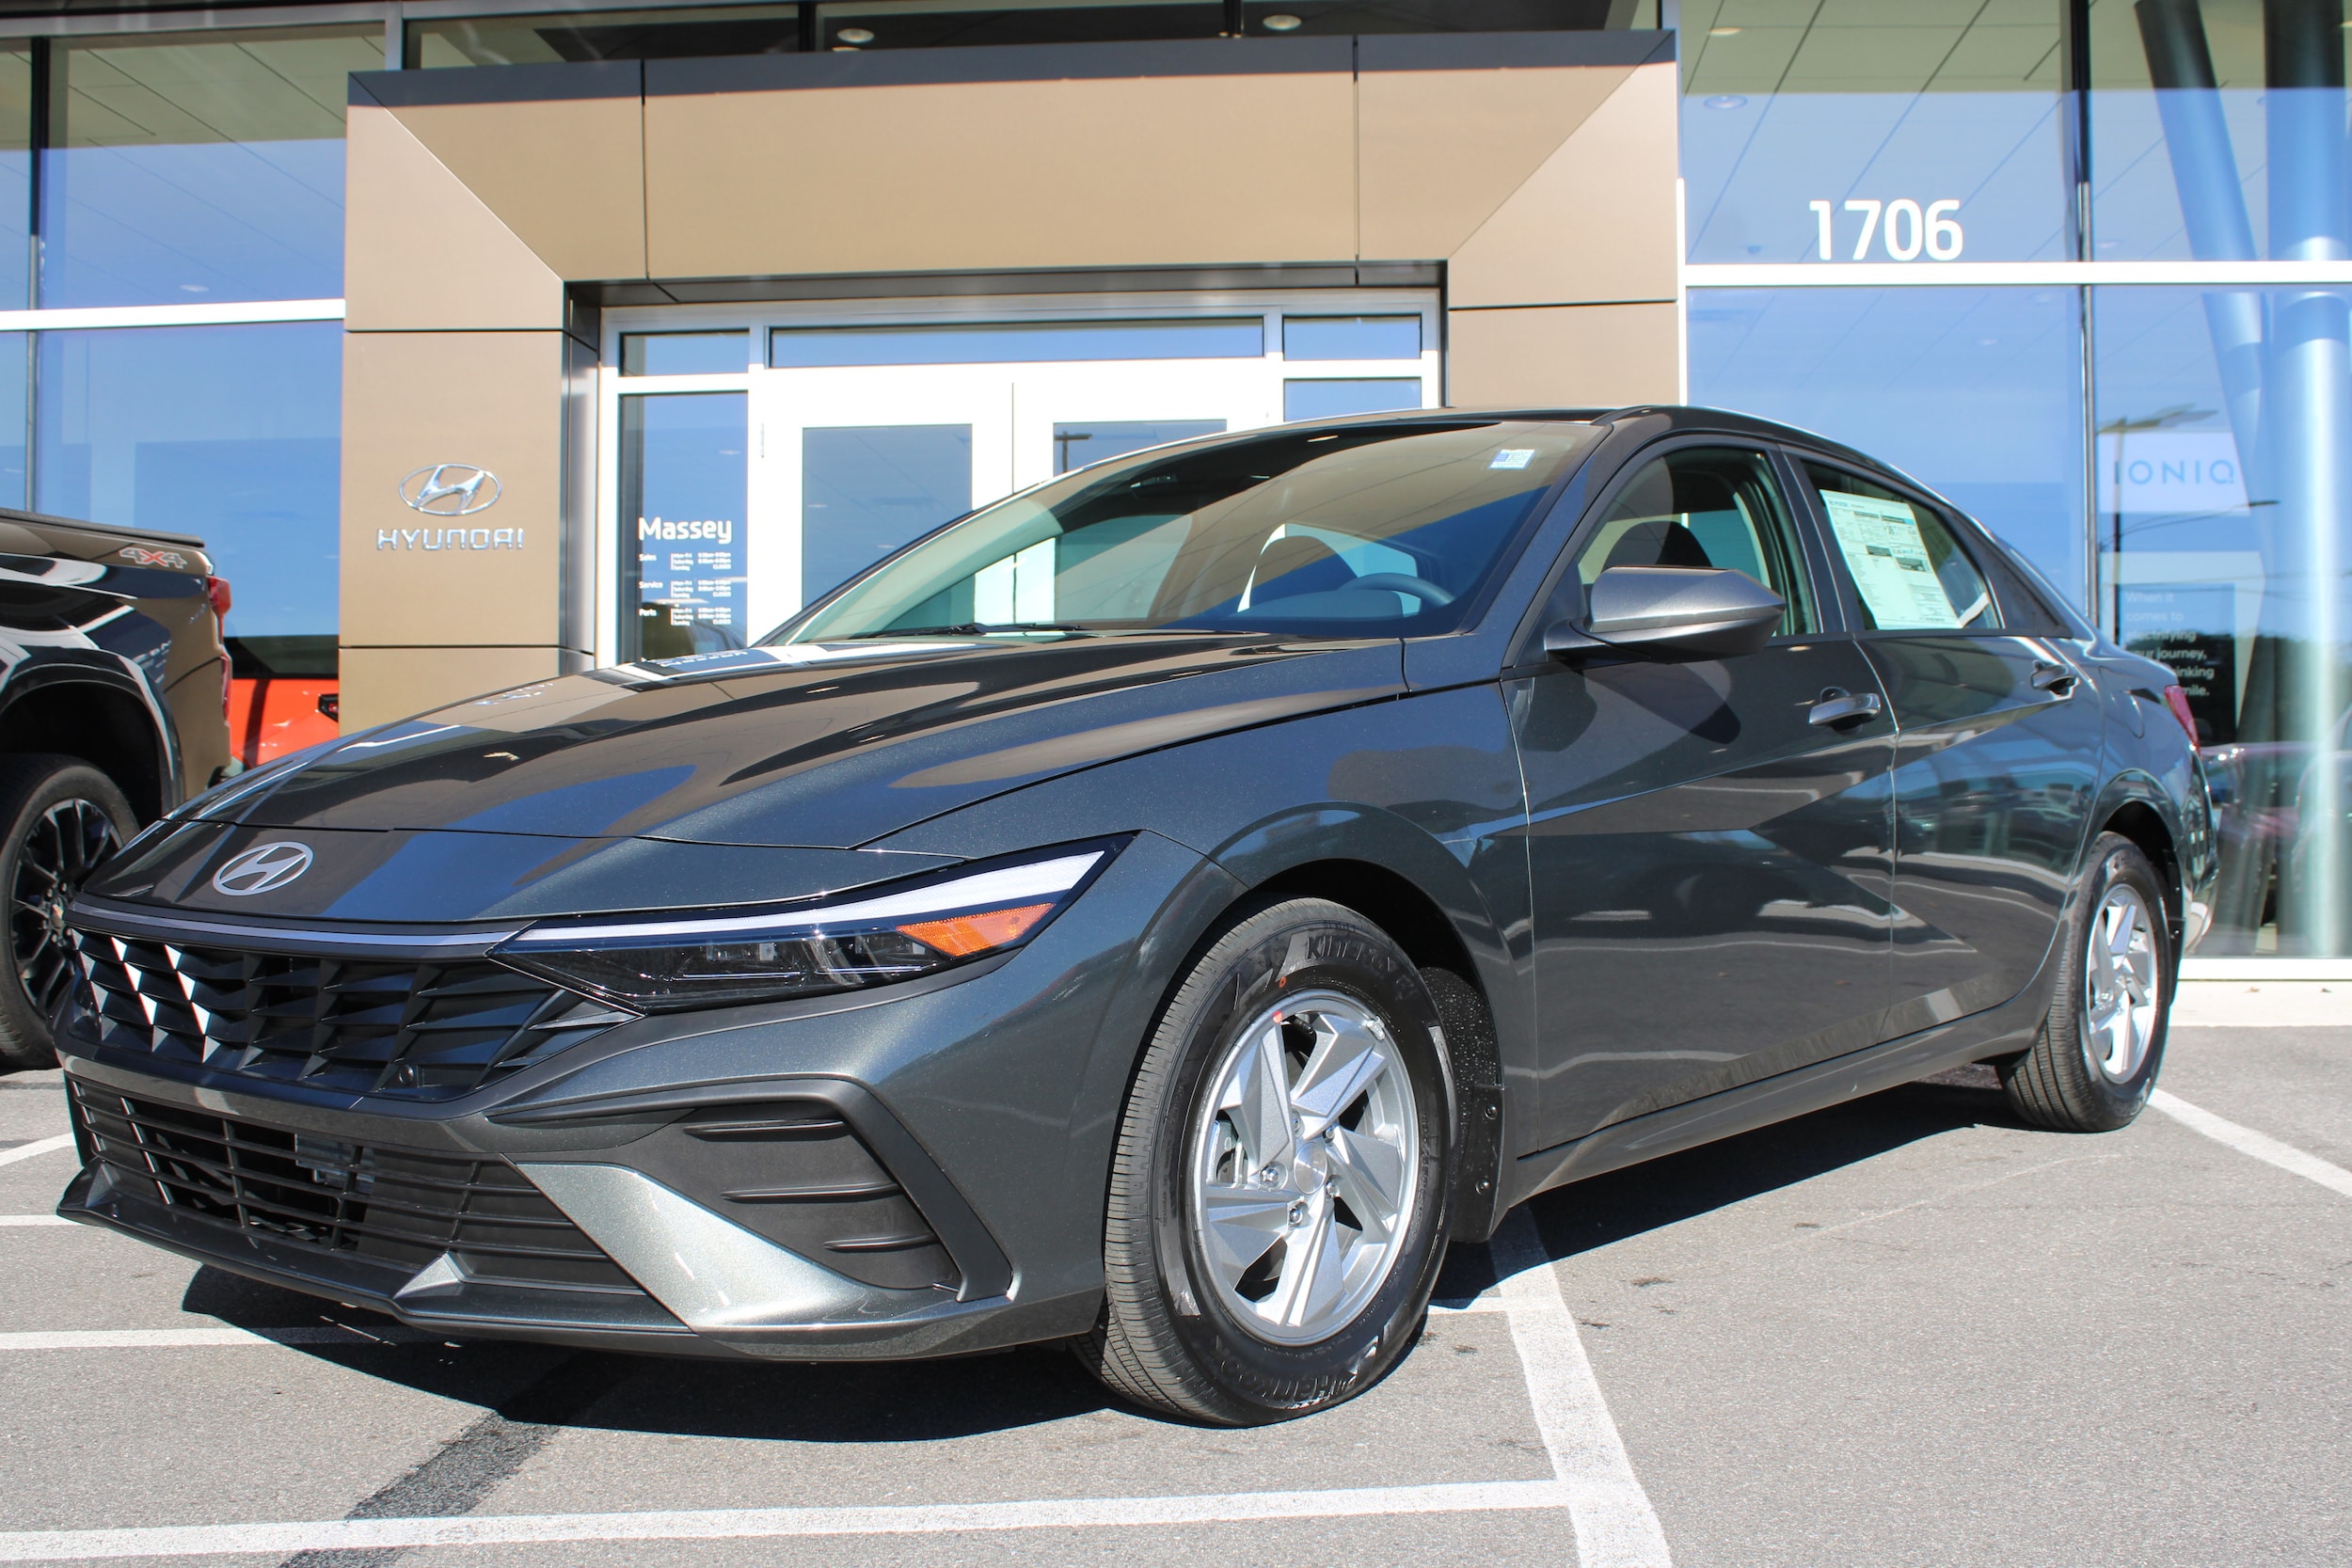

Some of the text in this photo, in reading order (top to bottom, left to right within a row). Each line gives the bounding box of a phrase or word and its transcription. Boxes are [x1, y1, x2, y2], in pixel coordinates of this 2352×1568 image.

[1809, 198, 1963, 261] 1706
[2115, 459, 2234, 484] IONIQ
[377, 528, 523, 550] HYUNDAI
[639, 516, 733, 545] Massey
